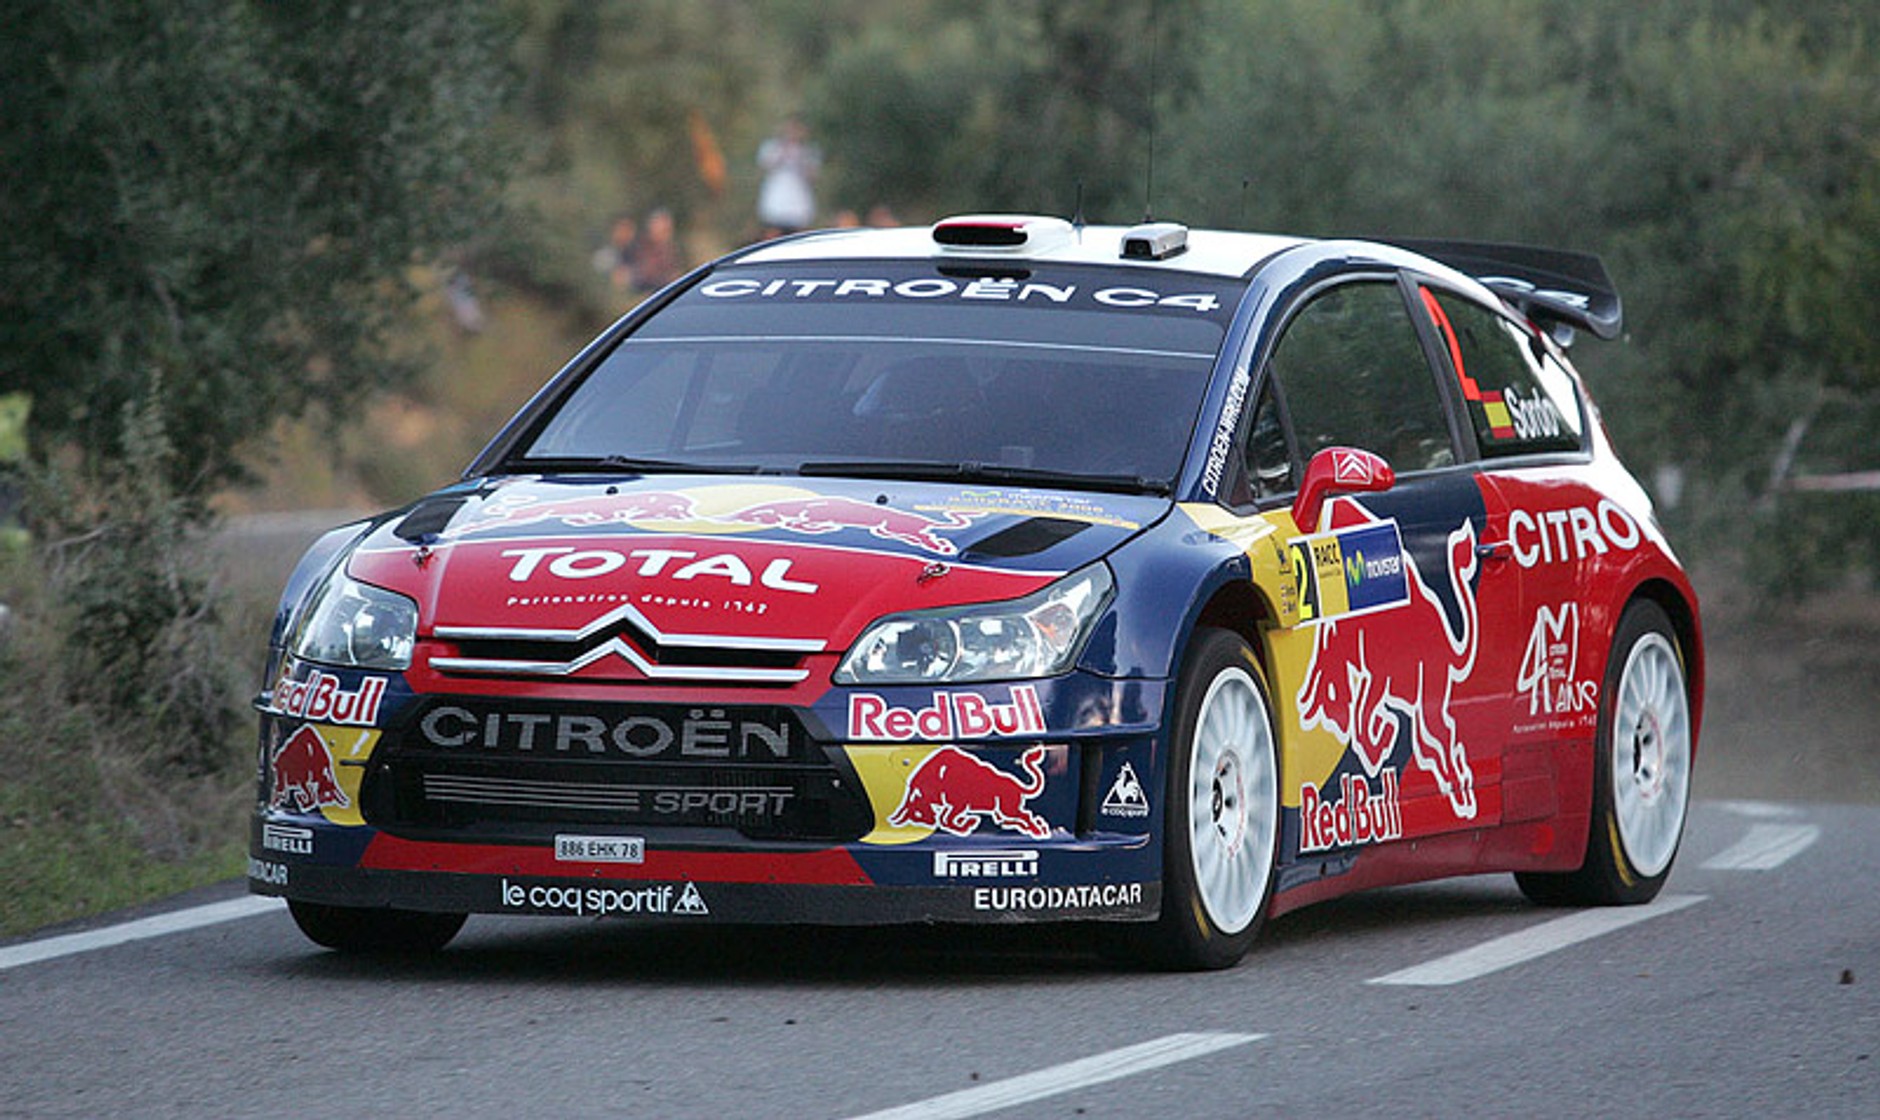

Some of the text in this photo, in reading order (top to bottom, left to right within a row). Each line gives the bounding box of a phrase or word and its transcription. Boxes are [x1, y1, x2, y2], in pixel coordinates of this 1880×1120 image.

[700, 277, 1221, 311] CITROËN C4
[1504, 386, 1560, 439] Sordo
[501, 547, 819, 594] TOTAL
[1290, 544, 1313, 619] 2
[304, 674, 388, 727] Bull
[848, 684, 1047, 741] Red Bull
[420, 706, 790, 758] CITROËN
[653, 793, 794, 816] SPORT
[1300, 767, 1402, 853] Red Bull
[263, 824, 313, 854] PIRELLI
[561, 840, 638, 858] 886 EHK 78
[934, 850, 1039, 877] PIRELLI
[502, 878, 673, 915] le coq sportif
[975, 883, 1142, 910] EURODATACAR
